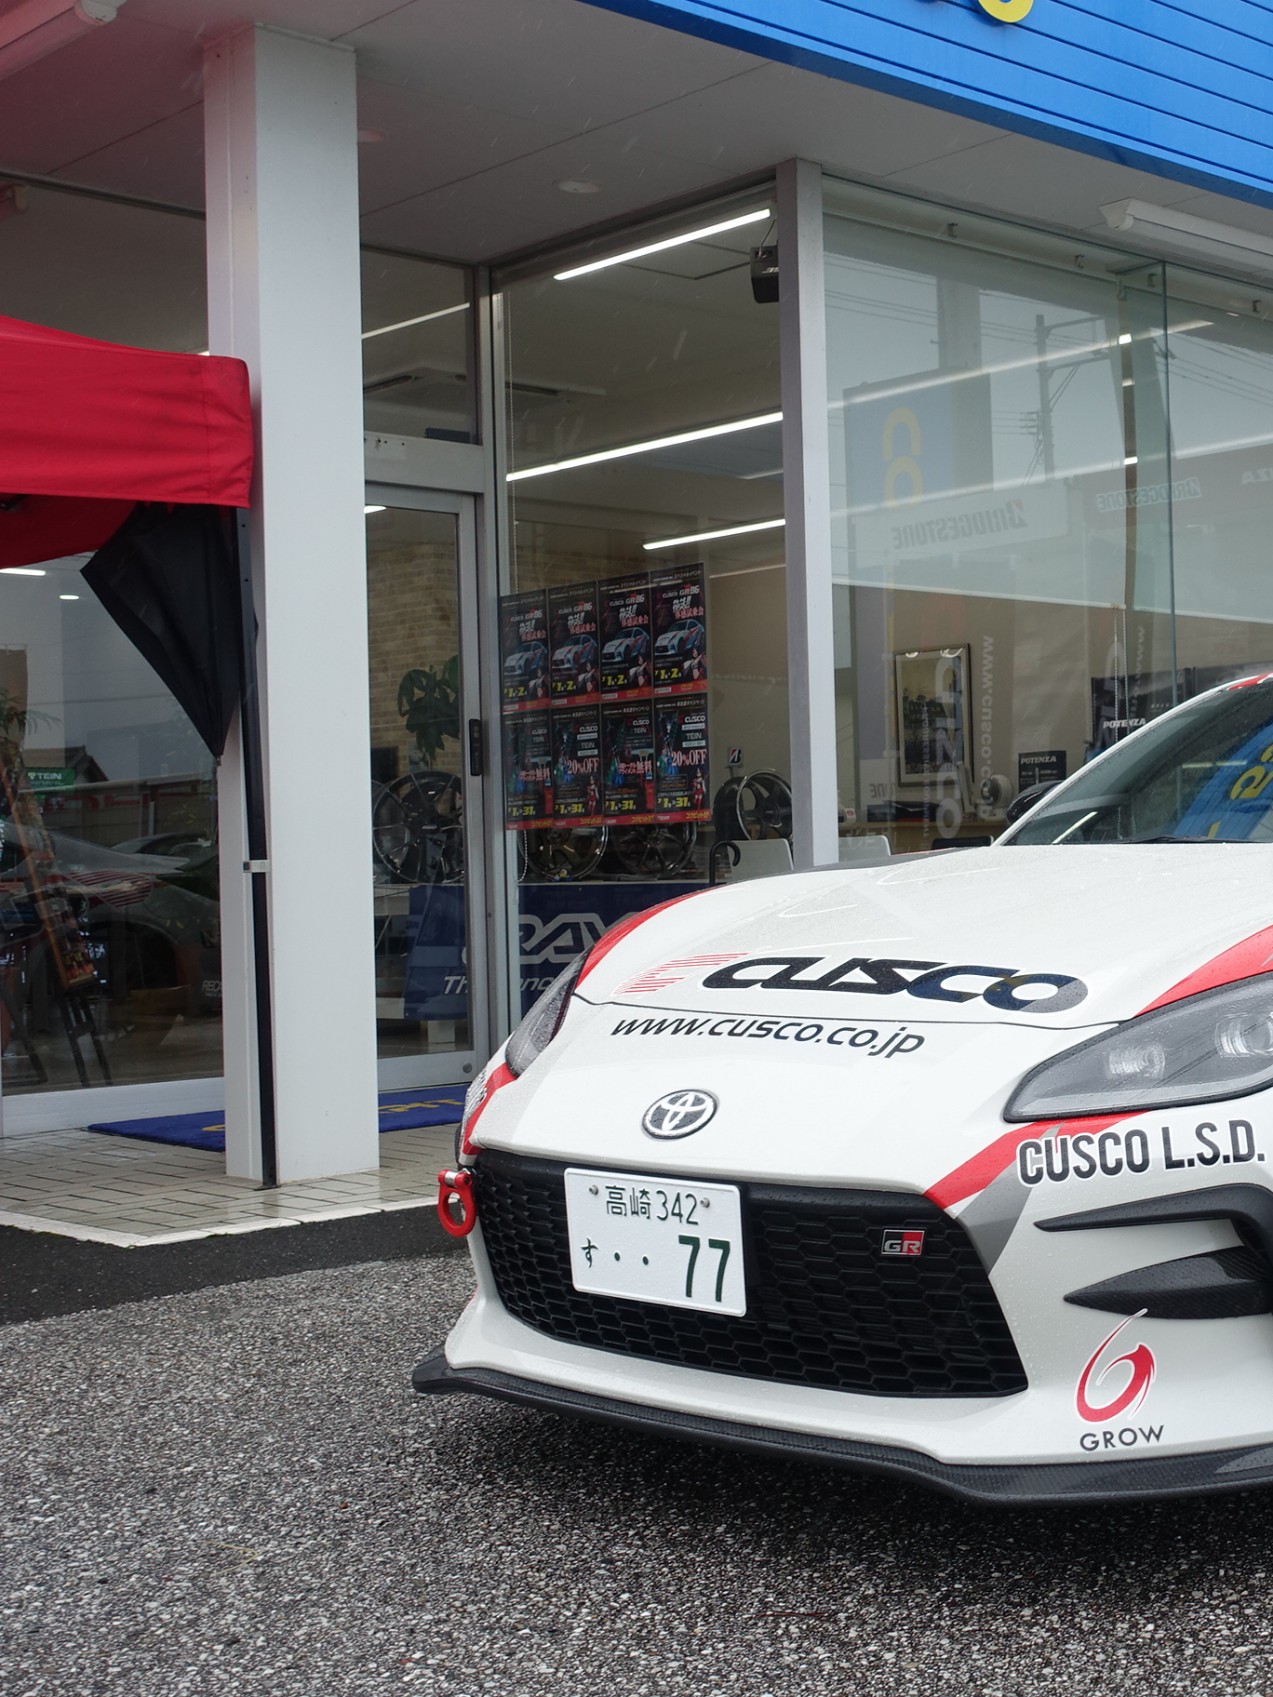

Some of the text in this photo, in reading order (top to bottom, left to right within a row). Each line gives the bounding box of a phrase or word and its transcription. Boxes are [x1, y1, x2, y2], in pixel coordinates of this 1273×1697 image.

[1103, 718, 1147, 730] POTENZA
[1020, 755, 1058, 765] POTENZA
[703, 956, 1090, 1015] CUSCO
[610, 1017, 926, 1059] www.cusco.co.jp
[1019, 1118, 1266, 1185] CUSCO L.S.D.
[605, 1185, 699, 1226] 高崎 342
[883, 1239, 922, 1254] GR
[581, 1234, 731, 1303] す 77
[1079, 1425, 1164, 1452] GROW
